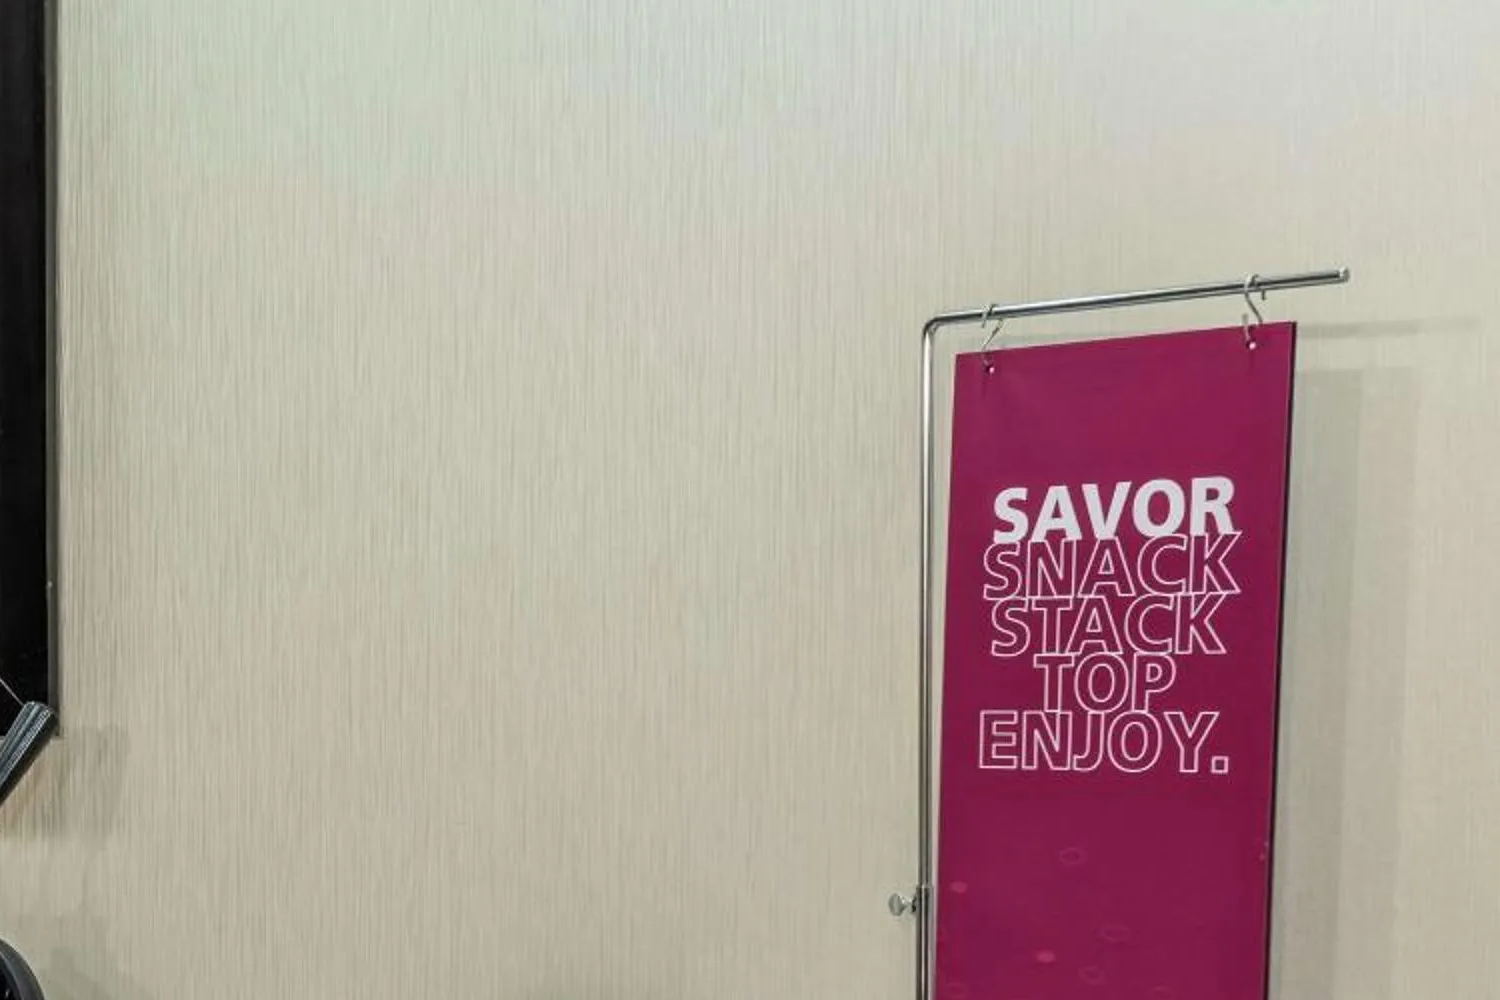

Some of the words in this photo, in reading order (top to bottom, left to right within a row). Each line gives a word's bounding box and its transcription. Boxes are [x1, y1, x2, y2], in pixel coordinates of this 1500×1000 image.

[994, 476, 1235, 544] SAVOR
[984, 532, 1241, 599] SNACK
[991, 592, 1226, 657] STACK
[1033, 652, 1176, 713] TOP
[979, 710, 1229, 773] ENJOY.
